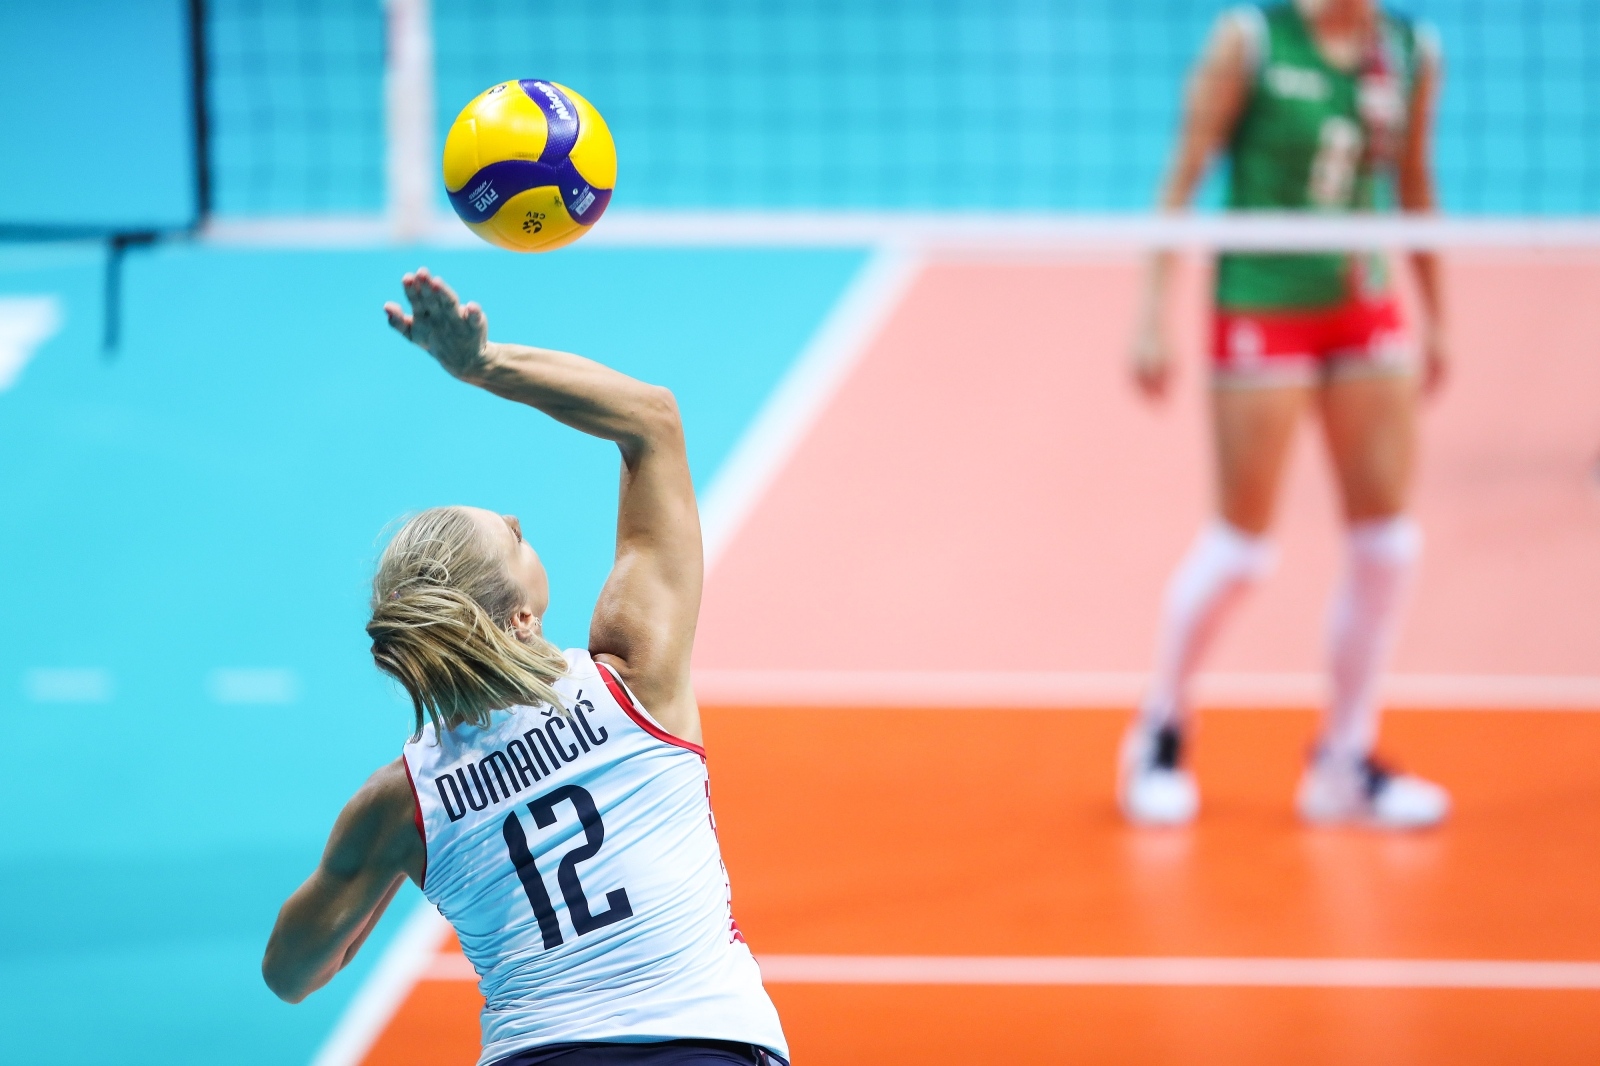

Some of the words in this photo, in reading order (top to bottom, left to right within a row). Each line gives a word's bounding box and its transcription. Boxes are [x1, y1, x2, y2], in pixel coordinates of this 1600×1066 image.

[474, 188, 499, 213] FIVB
[526, 210, 546, 220] CEV
[434, 689, 609, 823] DUMANČIĆ
[502, 784, 634, 951] 12
